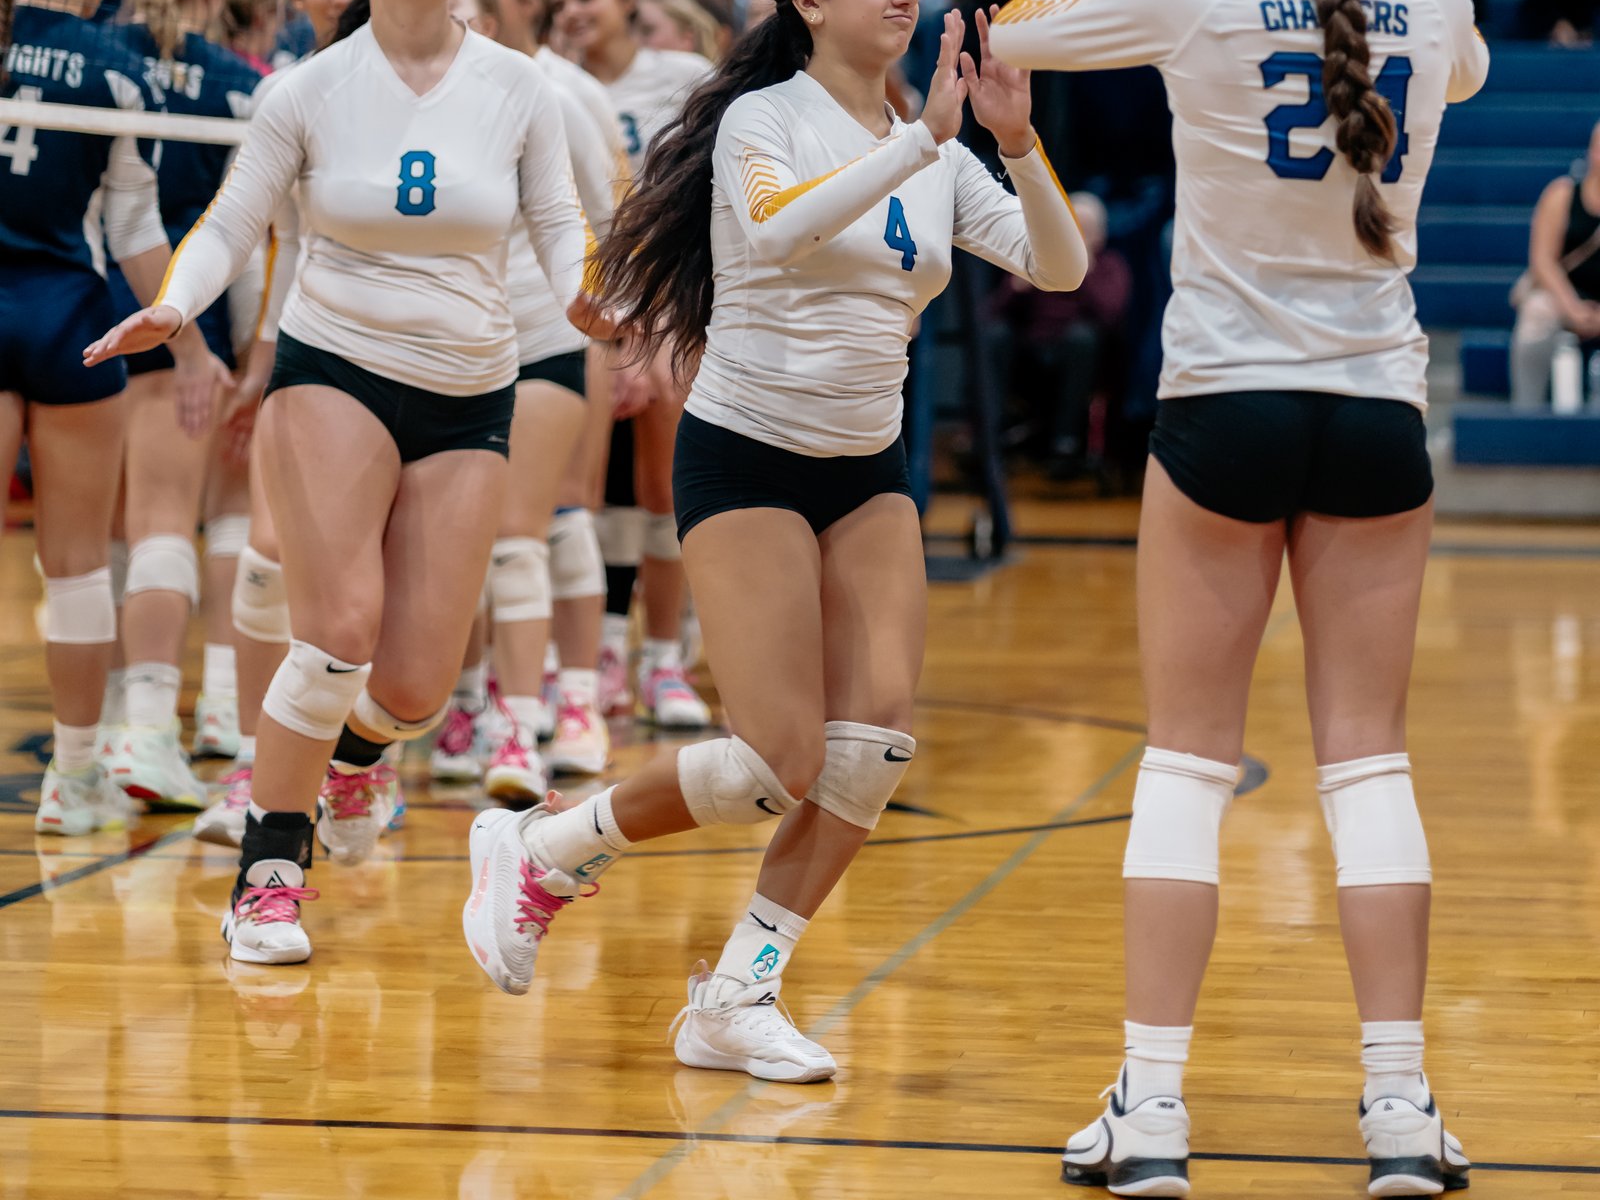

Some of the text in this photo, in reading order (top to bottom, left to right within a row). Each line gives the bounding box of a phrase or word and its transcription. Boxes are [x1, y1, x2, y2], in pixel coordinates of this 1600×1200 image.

[1259, 0, 1409, 37] CHARS
[7, 43, 86, 89] IGHTS
[394, 150, 437, 217] 8
[883, 195, 918, 272] 4
